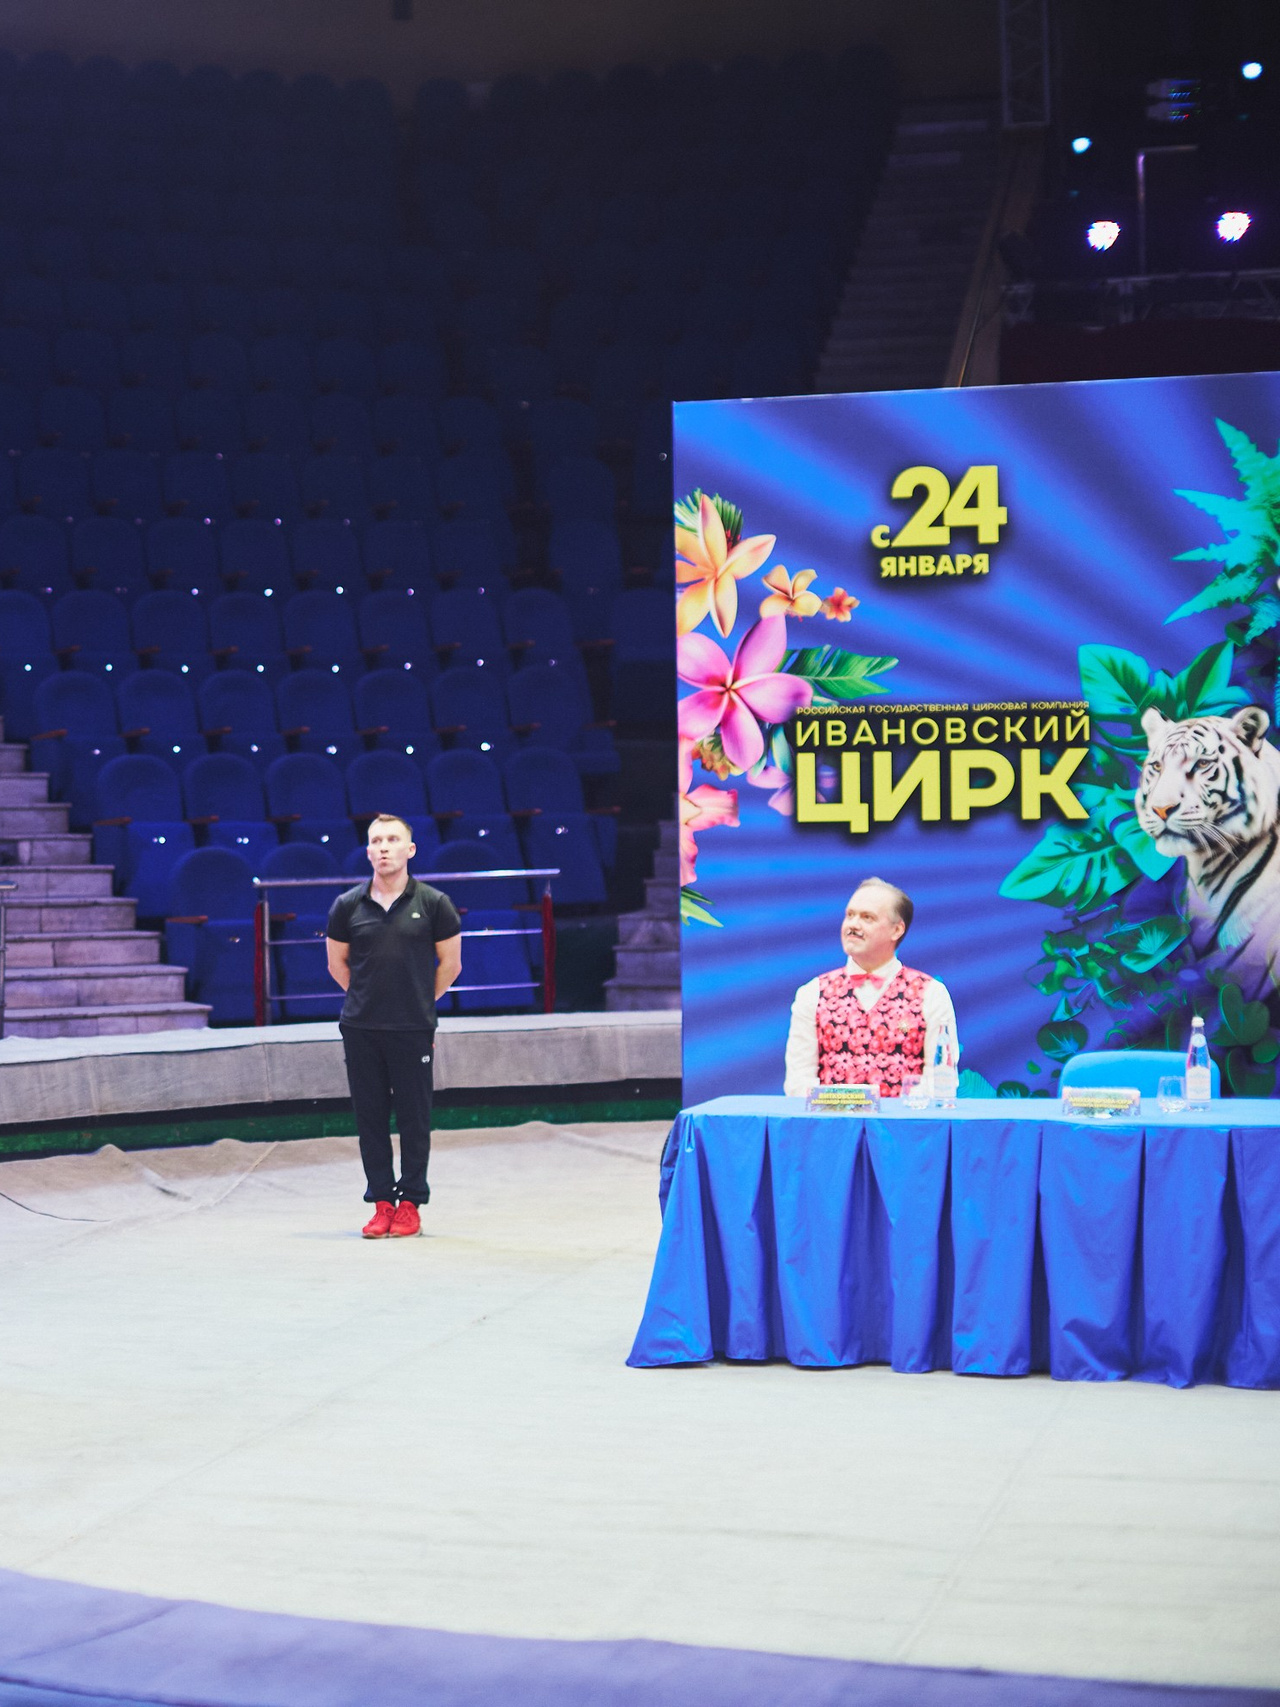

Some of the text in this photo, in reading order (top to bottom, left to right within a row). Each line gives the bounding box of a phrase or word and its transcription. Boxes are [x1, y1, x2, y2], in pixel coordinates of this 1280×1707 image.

[890, 464, 1008, 548] 24
[879, 552, 990, 578] ЯНВАРЯ
[796, 701, 1090, 715] РОССИЙСКАЯ ГОСУДАРСТВЕННАЯ ЦИРКОВАЯ КОМПАНИЯ
[796, 709, 1090, 747] ИВАНОВСКИЙ
[796, 747, 1090, 834] ЦИРК
